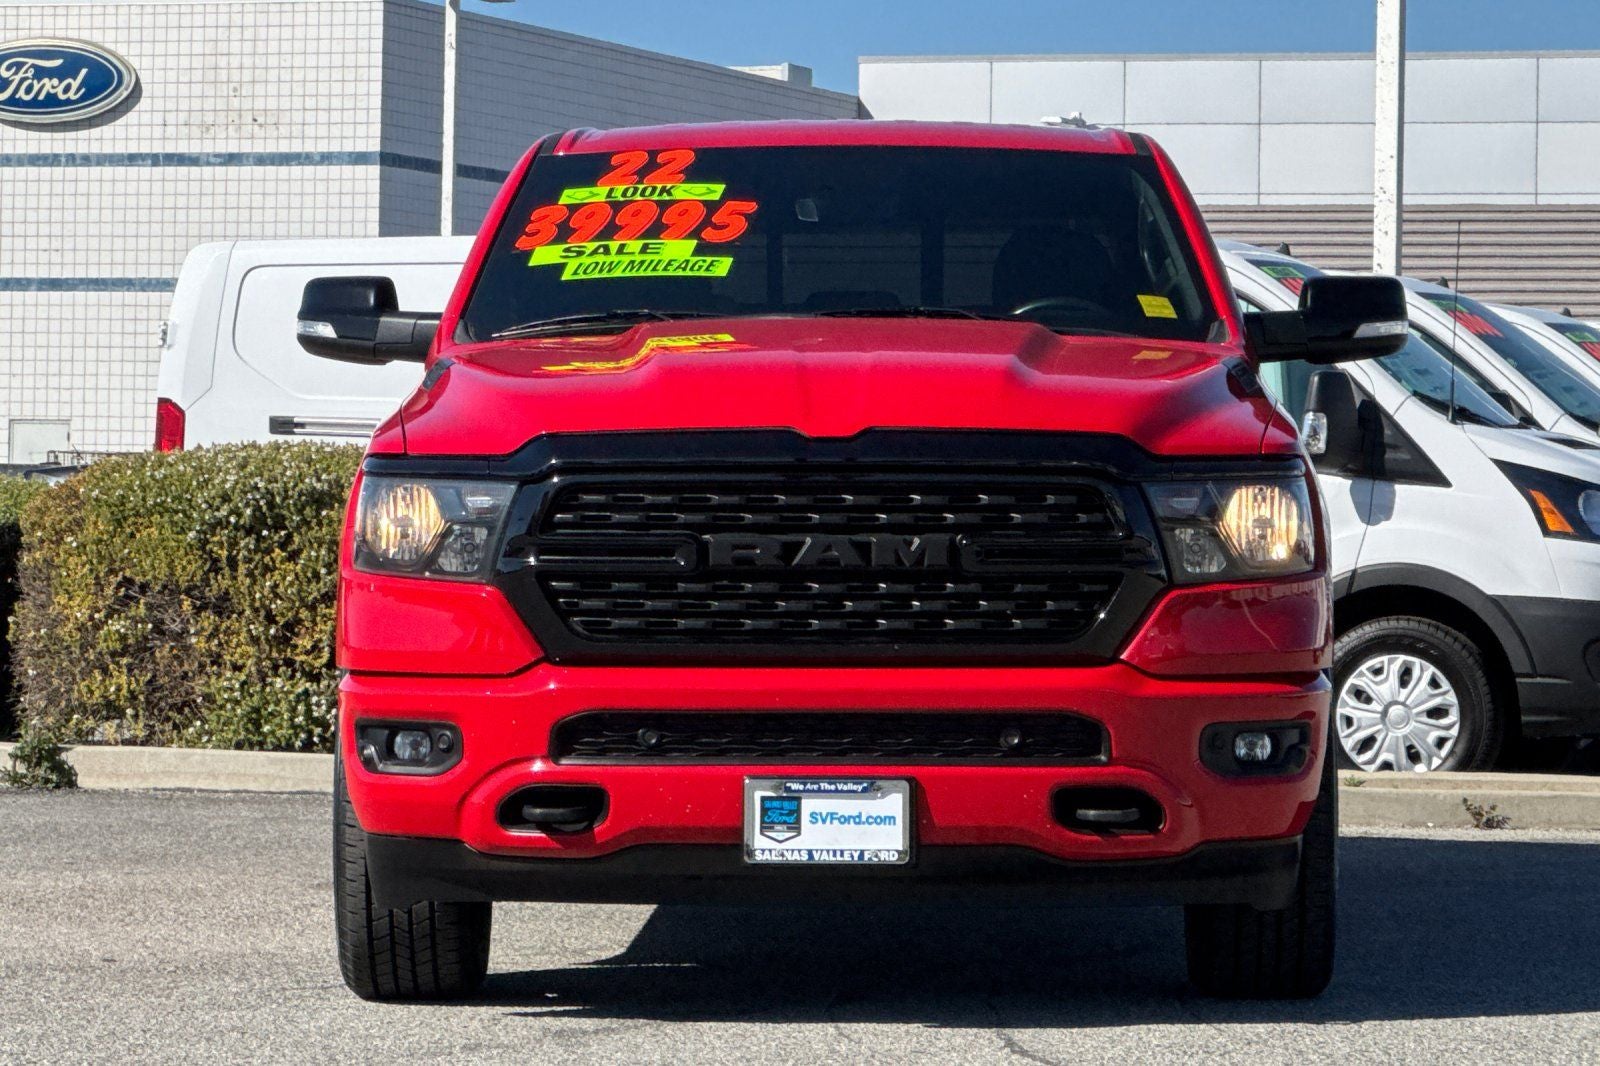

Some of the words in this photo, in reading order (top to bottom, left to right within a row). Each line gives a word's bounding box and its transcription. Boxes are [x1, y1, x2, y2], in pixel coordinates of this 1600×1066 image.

[0, 57, 88, 101] Ford
[597, 149, 696, 187] 22
[605, 185, 677, 200] LOOK
[515, 200, 758, 250] 39995
[560, 242, 667, 259] SALE
[572, 261, 622, 276] LOW
[622, 259, 719, 275] MILEAGE
[703, 532, 950, 567] RAM
[764, 809, 797, 823] Ford
[809, 812, 896, 826] SVFord.com
[812, 850, 860, 861] VALLEY
